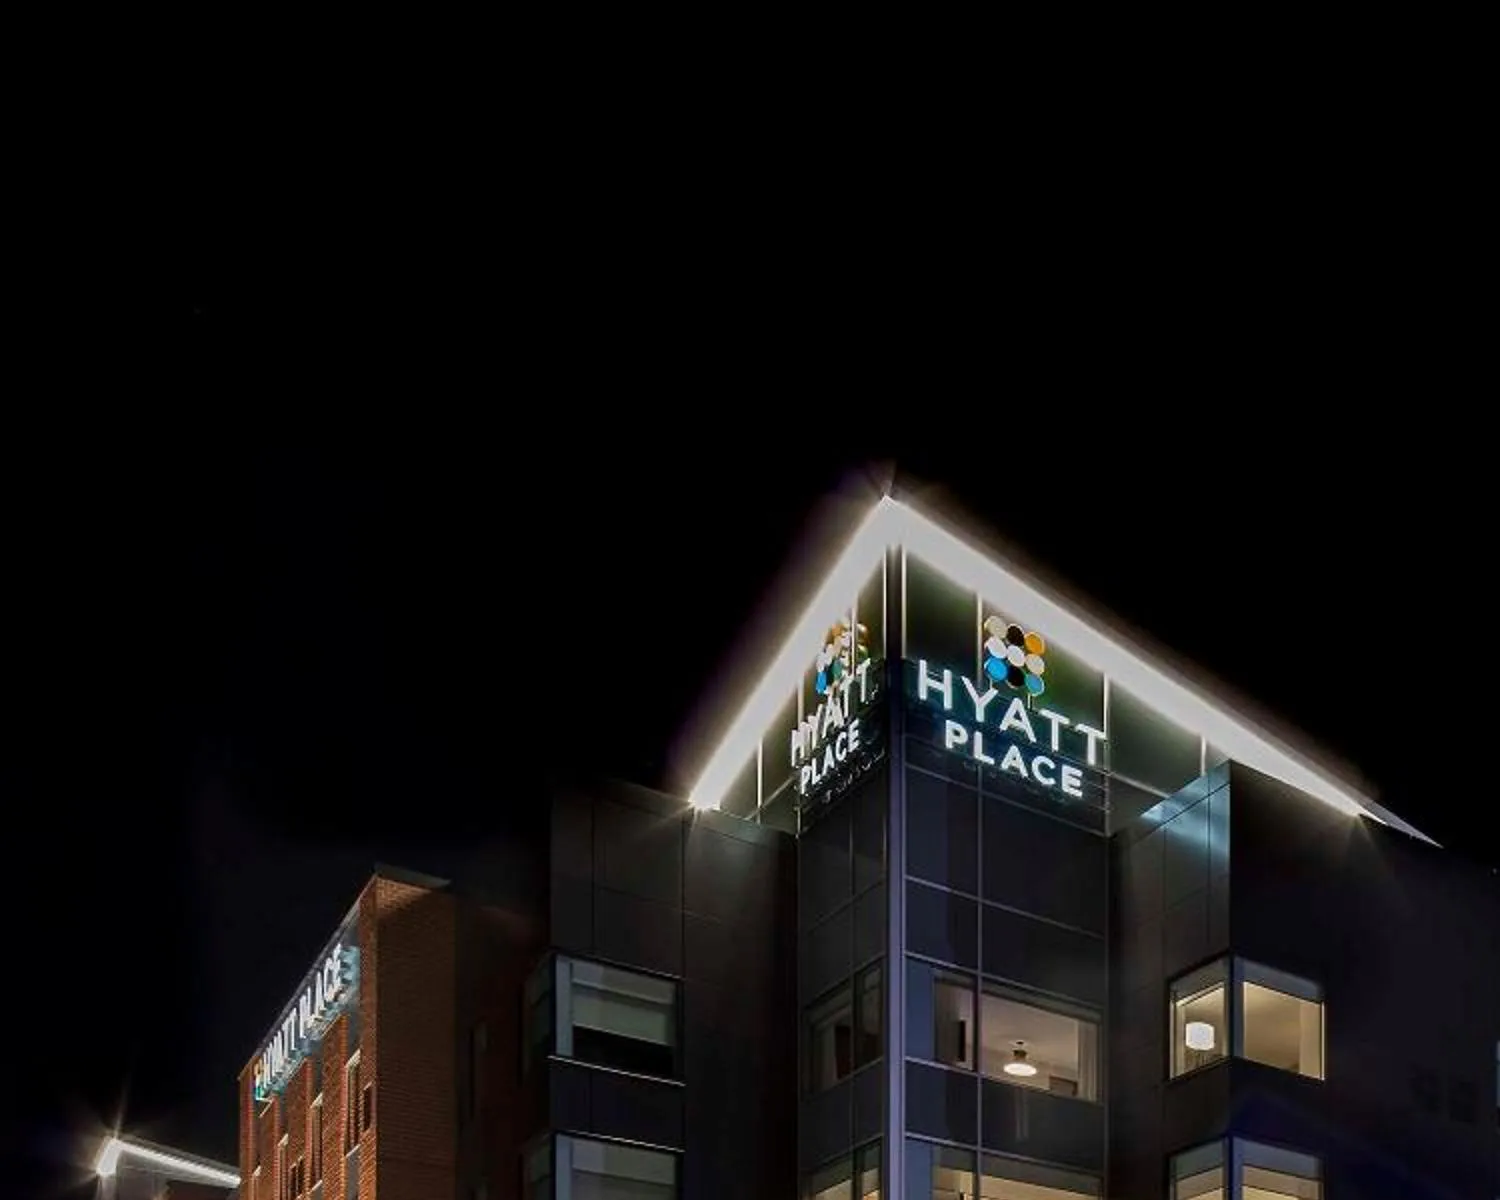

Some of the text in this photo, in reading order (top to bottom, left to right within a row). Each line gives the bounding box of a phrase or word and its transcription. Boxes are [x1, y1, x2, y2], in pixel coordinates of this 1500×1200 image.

[791, 657, 872, 767] HYATT
[799, 718, 860, 795] PLACE
[917, 659, 1107, 766] HYATT
[944, 719, 1084, 798] PLACE
